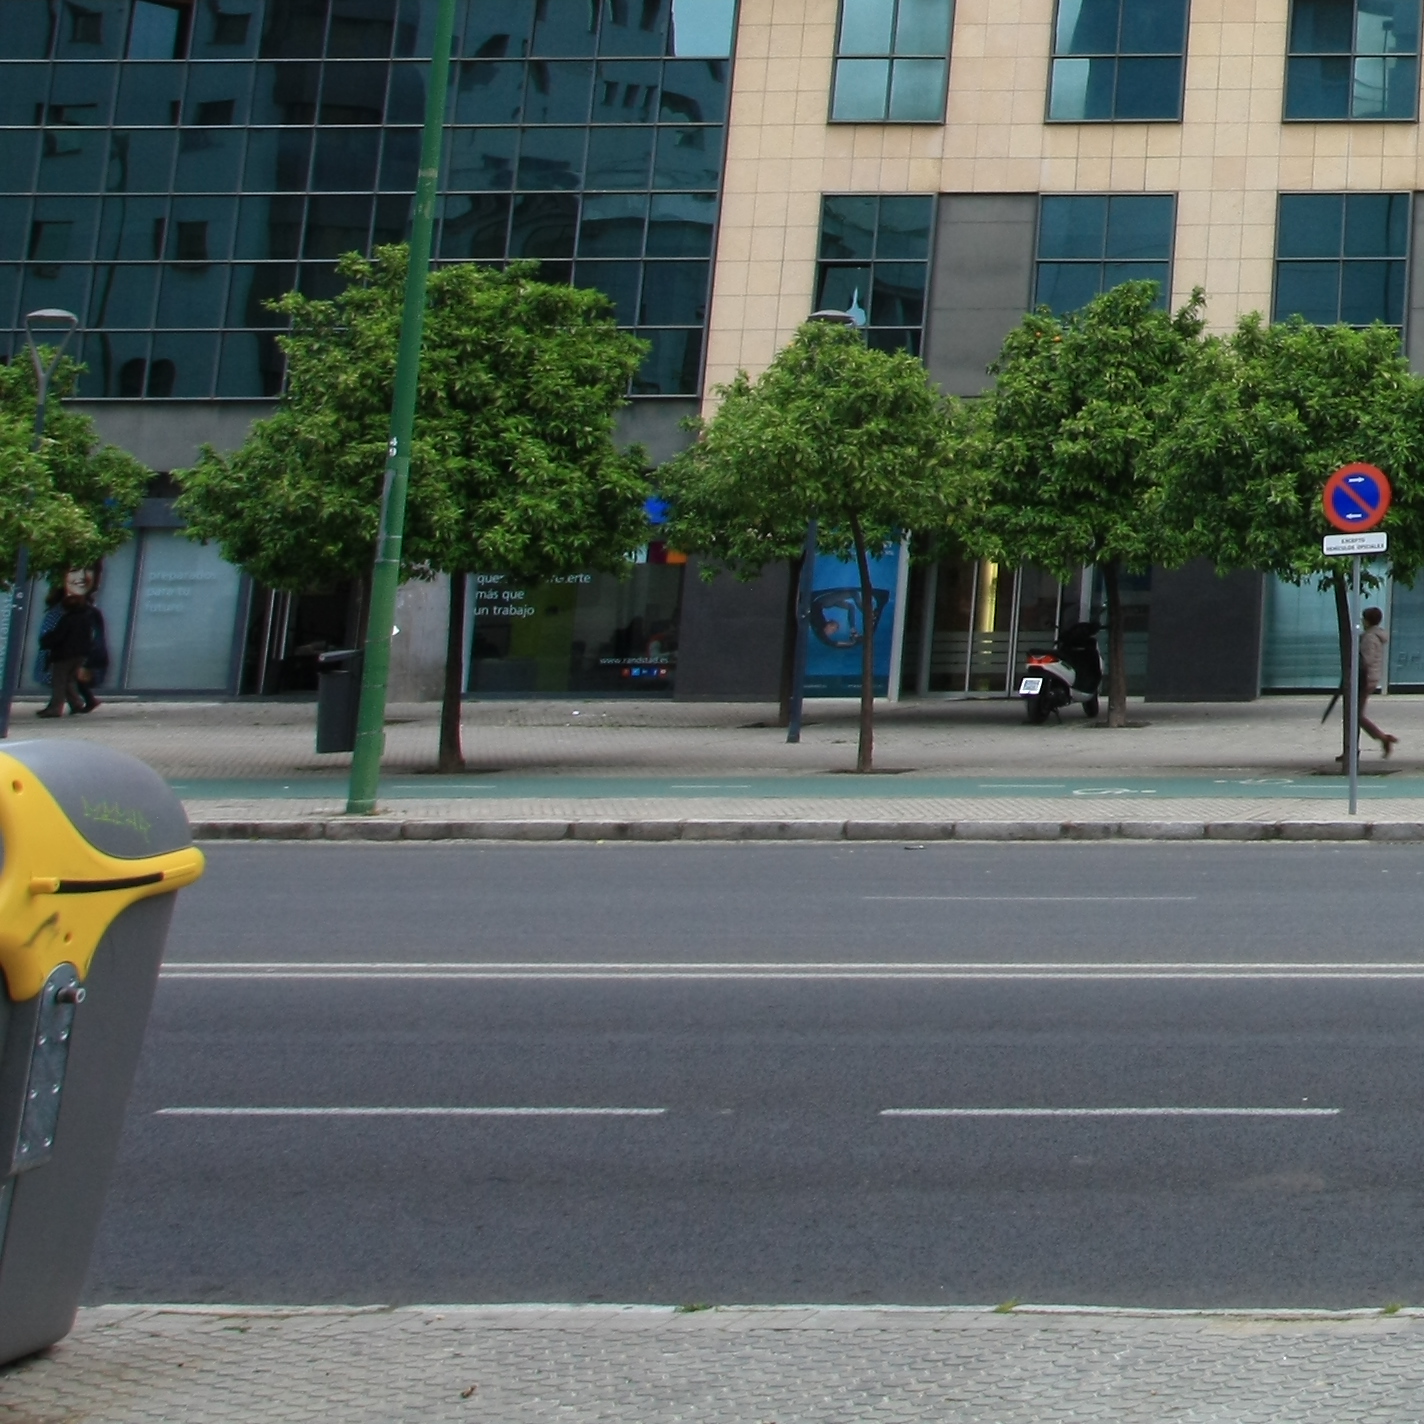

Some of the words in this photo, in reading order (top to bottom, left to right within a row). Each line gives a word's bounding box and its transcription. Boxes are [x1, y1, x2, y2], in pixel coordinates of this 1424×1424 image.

[475, 588, 498, 600] más
[502, 591, 526, 602] que
[474, 606, 489, 615] un
[493, 604, 535, 618] trabajo
[600, 656, 669, 664] www.randstad.es
